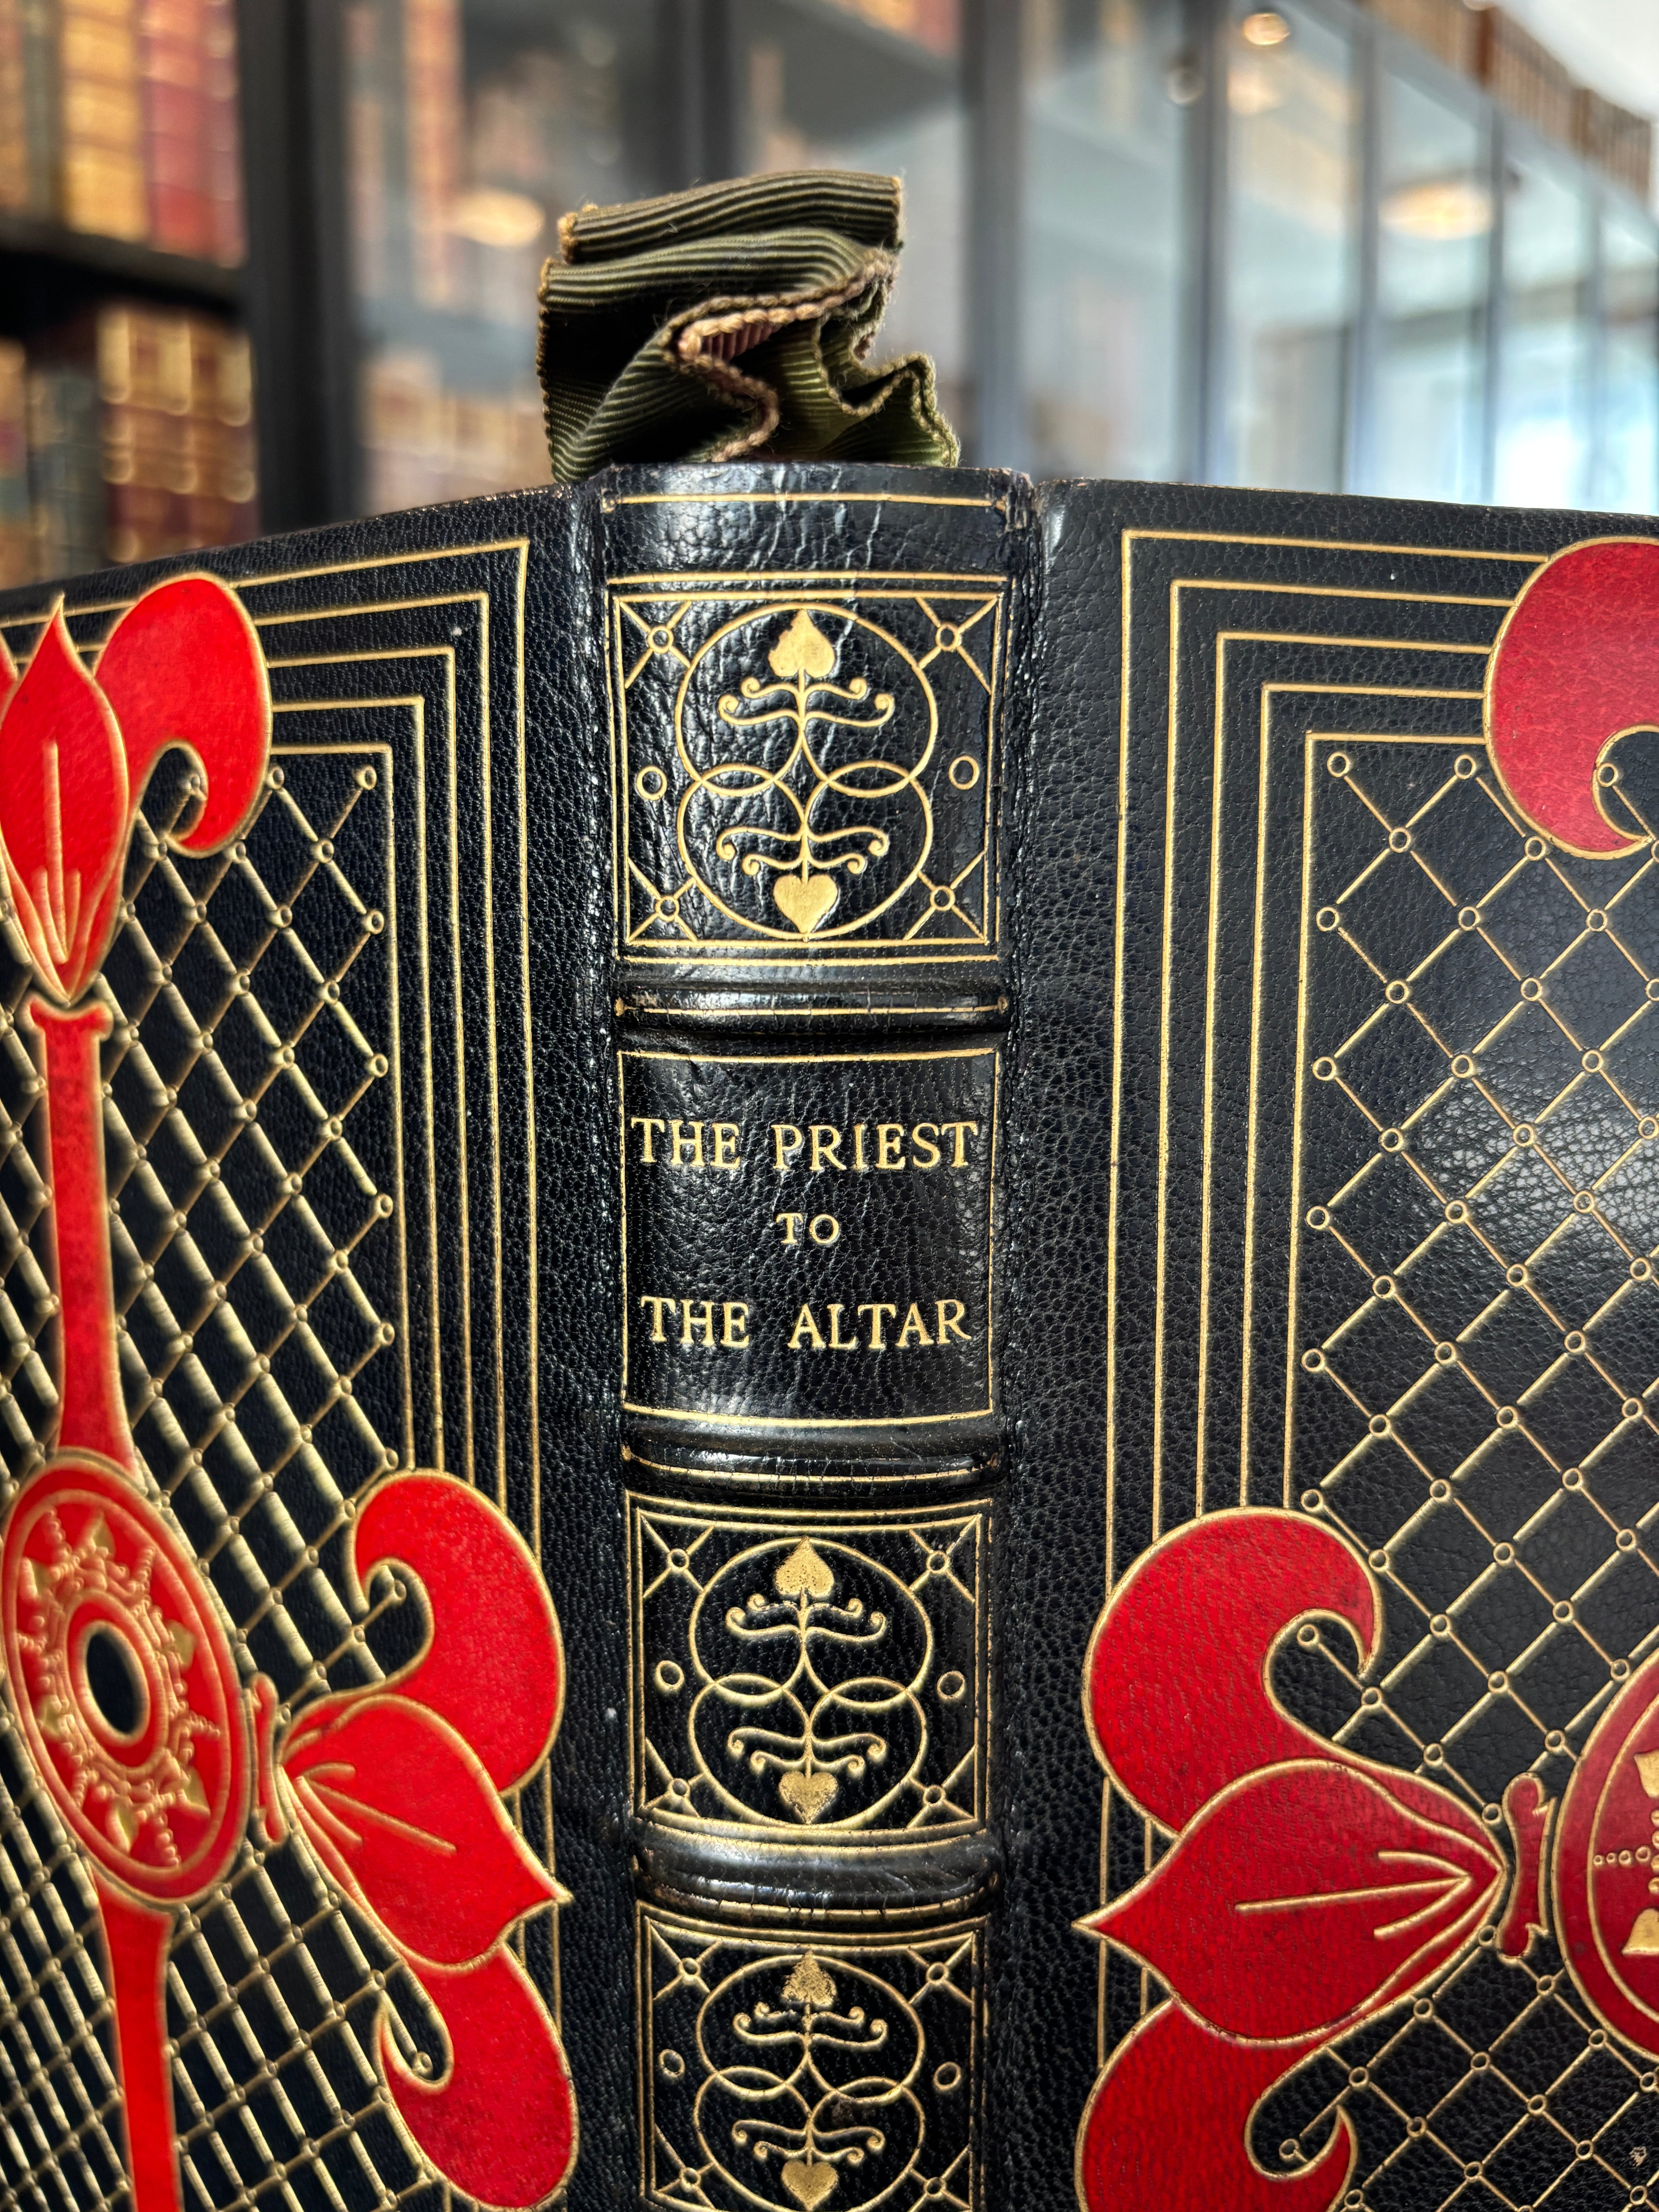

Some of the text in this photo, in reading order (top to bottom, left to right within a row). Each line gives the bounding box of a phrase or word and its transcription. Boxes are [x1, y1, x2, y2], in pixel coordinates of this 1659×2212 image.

[631, 1117, 979, 1171] THE PRIEST
[776, 1212, 840, 1244] TO
[641, 1296, 972, 1349] THE ALTAR
